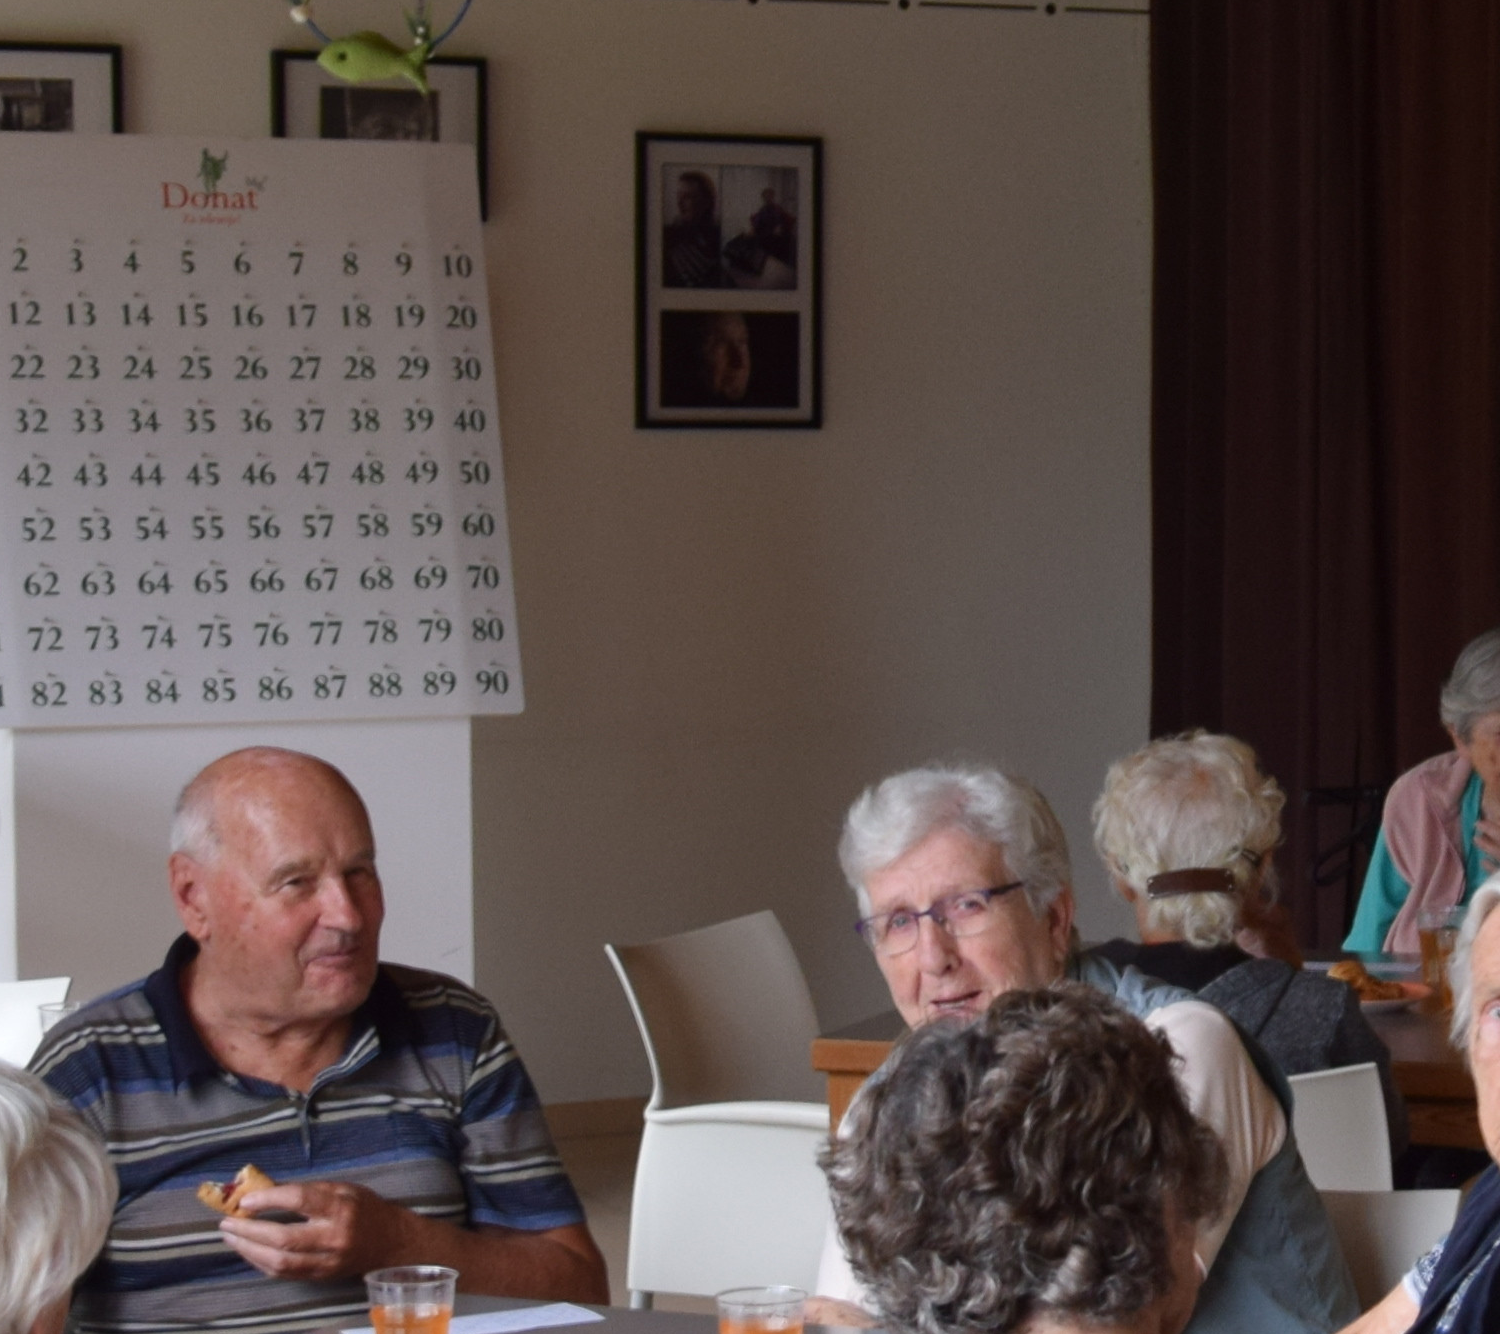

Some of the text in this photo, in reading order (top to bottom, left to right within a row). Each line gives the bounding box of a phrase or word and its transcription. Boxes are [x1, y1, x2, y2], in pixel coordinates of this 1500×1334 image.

[161, 181, 259, 211] Donat
[12, 246, 29, 273] 2
[70, 248, 85, 274] 3
[123, 250, 141, 274] 4
[180, 249, 196, 275] 5
[233, 252, 252, 276] 6
[288, 251, 305, 276] 7
[342, 252, 360, 276] 8
[394, 252, 413, 276] 9
[443, 254, 473, 279] 10
[9, 300, 42, 326] 12
[66, 301, 97, 327] 13
[121, 303, 154, 327] 14
[177, 302, 209, 328] 15
[232, 304, 265, 328] 16
[287, 303, 318, 329] 17
[341, 303, 372, 328] 18
[395, 304, 426, 328] 19
[445, 304, 478, 330] 20
[10, 353, 46, 380] 22
[67, 354, 101, 380] 23
[123, 354, 158, 380] 24
[179, 355, 213, 381] 25
[234, 355, 269, 381] 26
[289, 355, 322, 381] 27
[343, 355, 377, 381] 28
[397, 355, 430, 380] 29
[451, 356, 482, 381] 30
[15, 407, 49, 434] 32
[72, 408, 105, 434] 33
[129, 408, 161, 434] 34
[185, 408, 217, 434] 35
[240, 408, 273, 433] 36
[295, 407, 326, 433] 37
[349, 407, 381, 433] 38
[403, 407, 435, 433] 39
[453, 409, 486, 433] 40
[16, 461, 53, 488] 42
[73, 461, 109, 488] 43
[130, 463, 165, 487] 44
[186, 461, 221, 487] 45
[241, 462, 277, 486] 46
[296, 460, 330, 486] 47
[351, 460, 386, 485] 48
[405, 460, 439, 484] 49
[459, 460, 491, 485] 50
[22, 516, 57, 543] 52
[79, 515, 112, 542] 53
[136, 515, 169, 541] 54
[191, 515, 225, 541] 55
[247, 514, 281, 540] 56
[302, 513, 335, 539] 57
[357, 513, 390, 538] 58
[411, 512, 444, 537] 59
[461, 513, 495, 537] 60
[22, 570, 60, 597] 62
[80, 570, 116, 596] 63
[137, 571, 173, 595] 64
[193, 568, 229, 594] 65
[249, 569, 286, 593] 66
[304, 566, 339, 592] 67
[359, 566, 394, 591] 68
[413, 565, 448, 590] 69
[466, 564, 500, 590] 70
[27, 625, 64, 652] 72
[84, 624, 120, 651] 73
[141, 624, 177, 650] 74
[198, 622, 233, 649] 75
[253, 622, 290, 647] 76
[308, 620, 343, 646] 77
[363, 619, 399, 645] 78
[417, 618, 453, 644] 79
[471, 617, 505, 642] 80
[31, 680, 68, 707] 82
[88, 679, 124, 706] 83
[145, 679, 181, 704] 84
[202, 677, 237, 703] 85
[258, 676, 294, 701] 86
[313, 674, 347, 699] 87
[368, 673, 403, 698] 88
[423, 671, 457, 696] 89
[475, 670, 509, 694] 90
